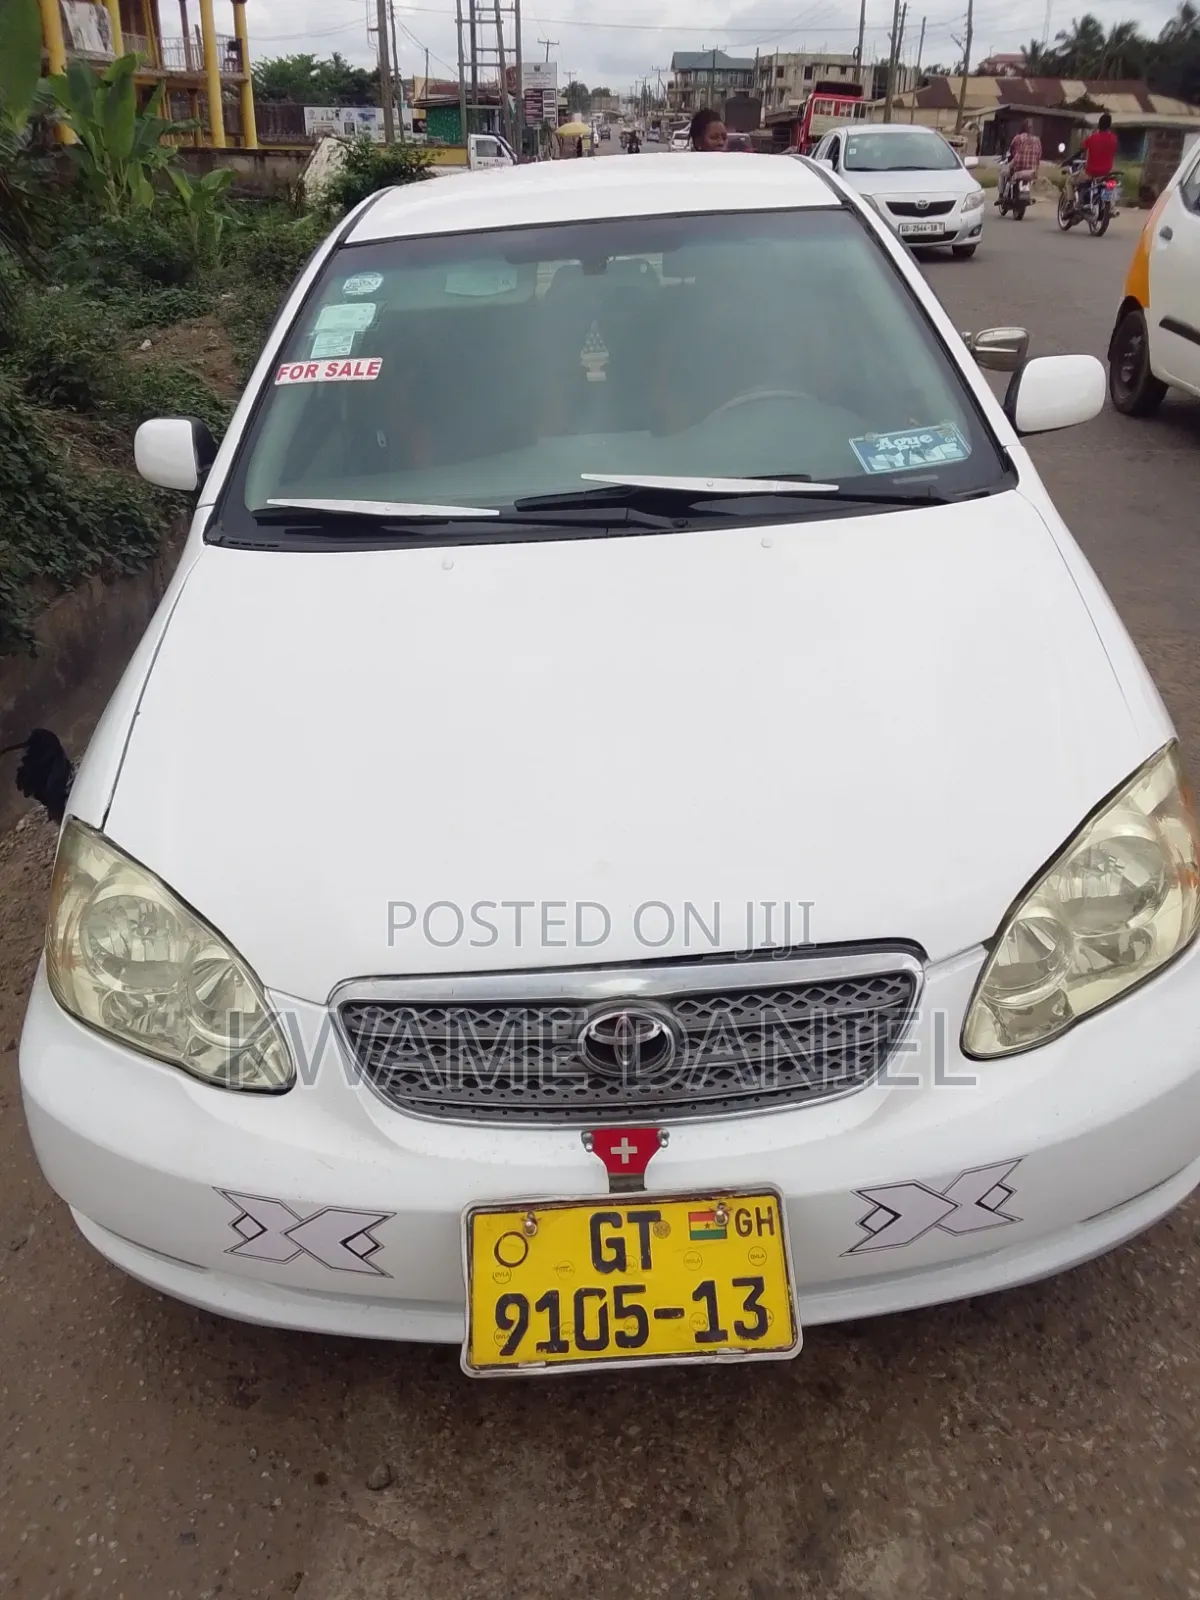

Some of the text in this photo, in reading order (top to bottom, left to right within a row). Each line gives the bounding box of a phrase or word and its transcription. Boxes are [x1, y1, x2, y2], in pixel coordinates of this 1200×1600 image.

[276, 361, 381, 381] FOR SALE
[589, 1210, 661, 1274] GT
[734, 1206, 775, 1237] GH
[495, 1277, 770, 1356] 9105-13
